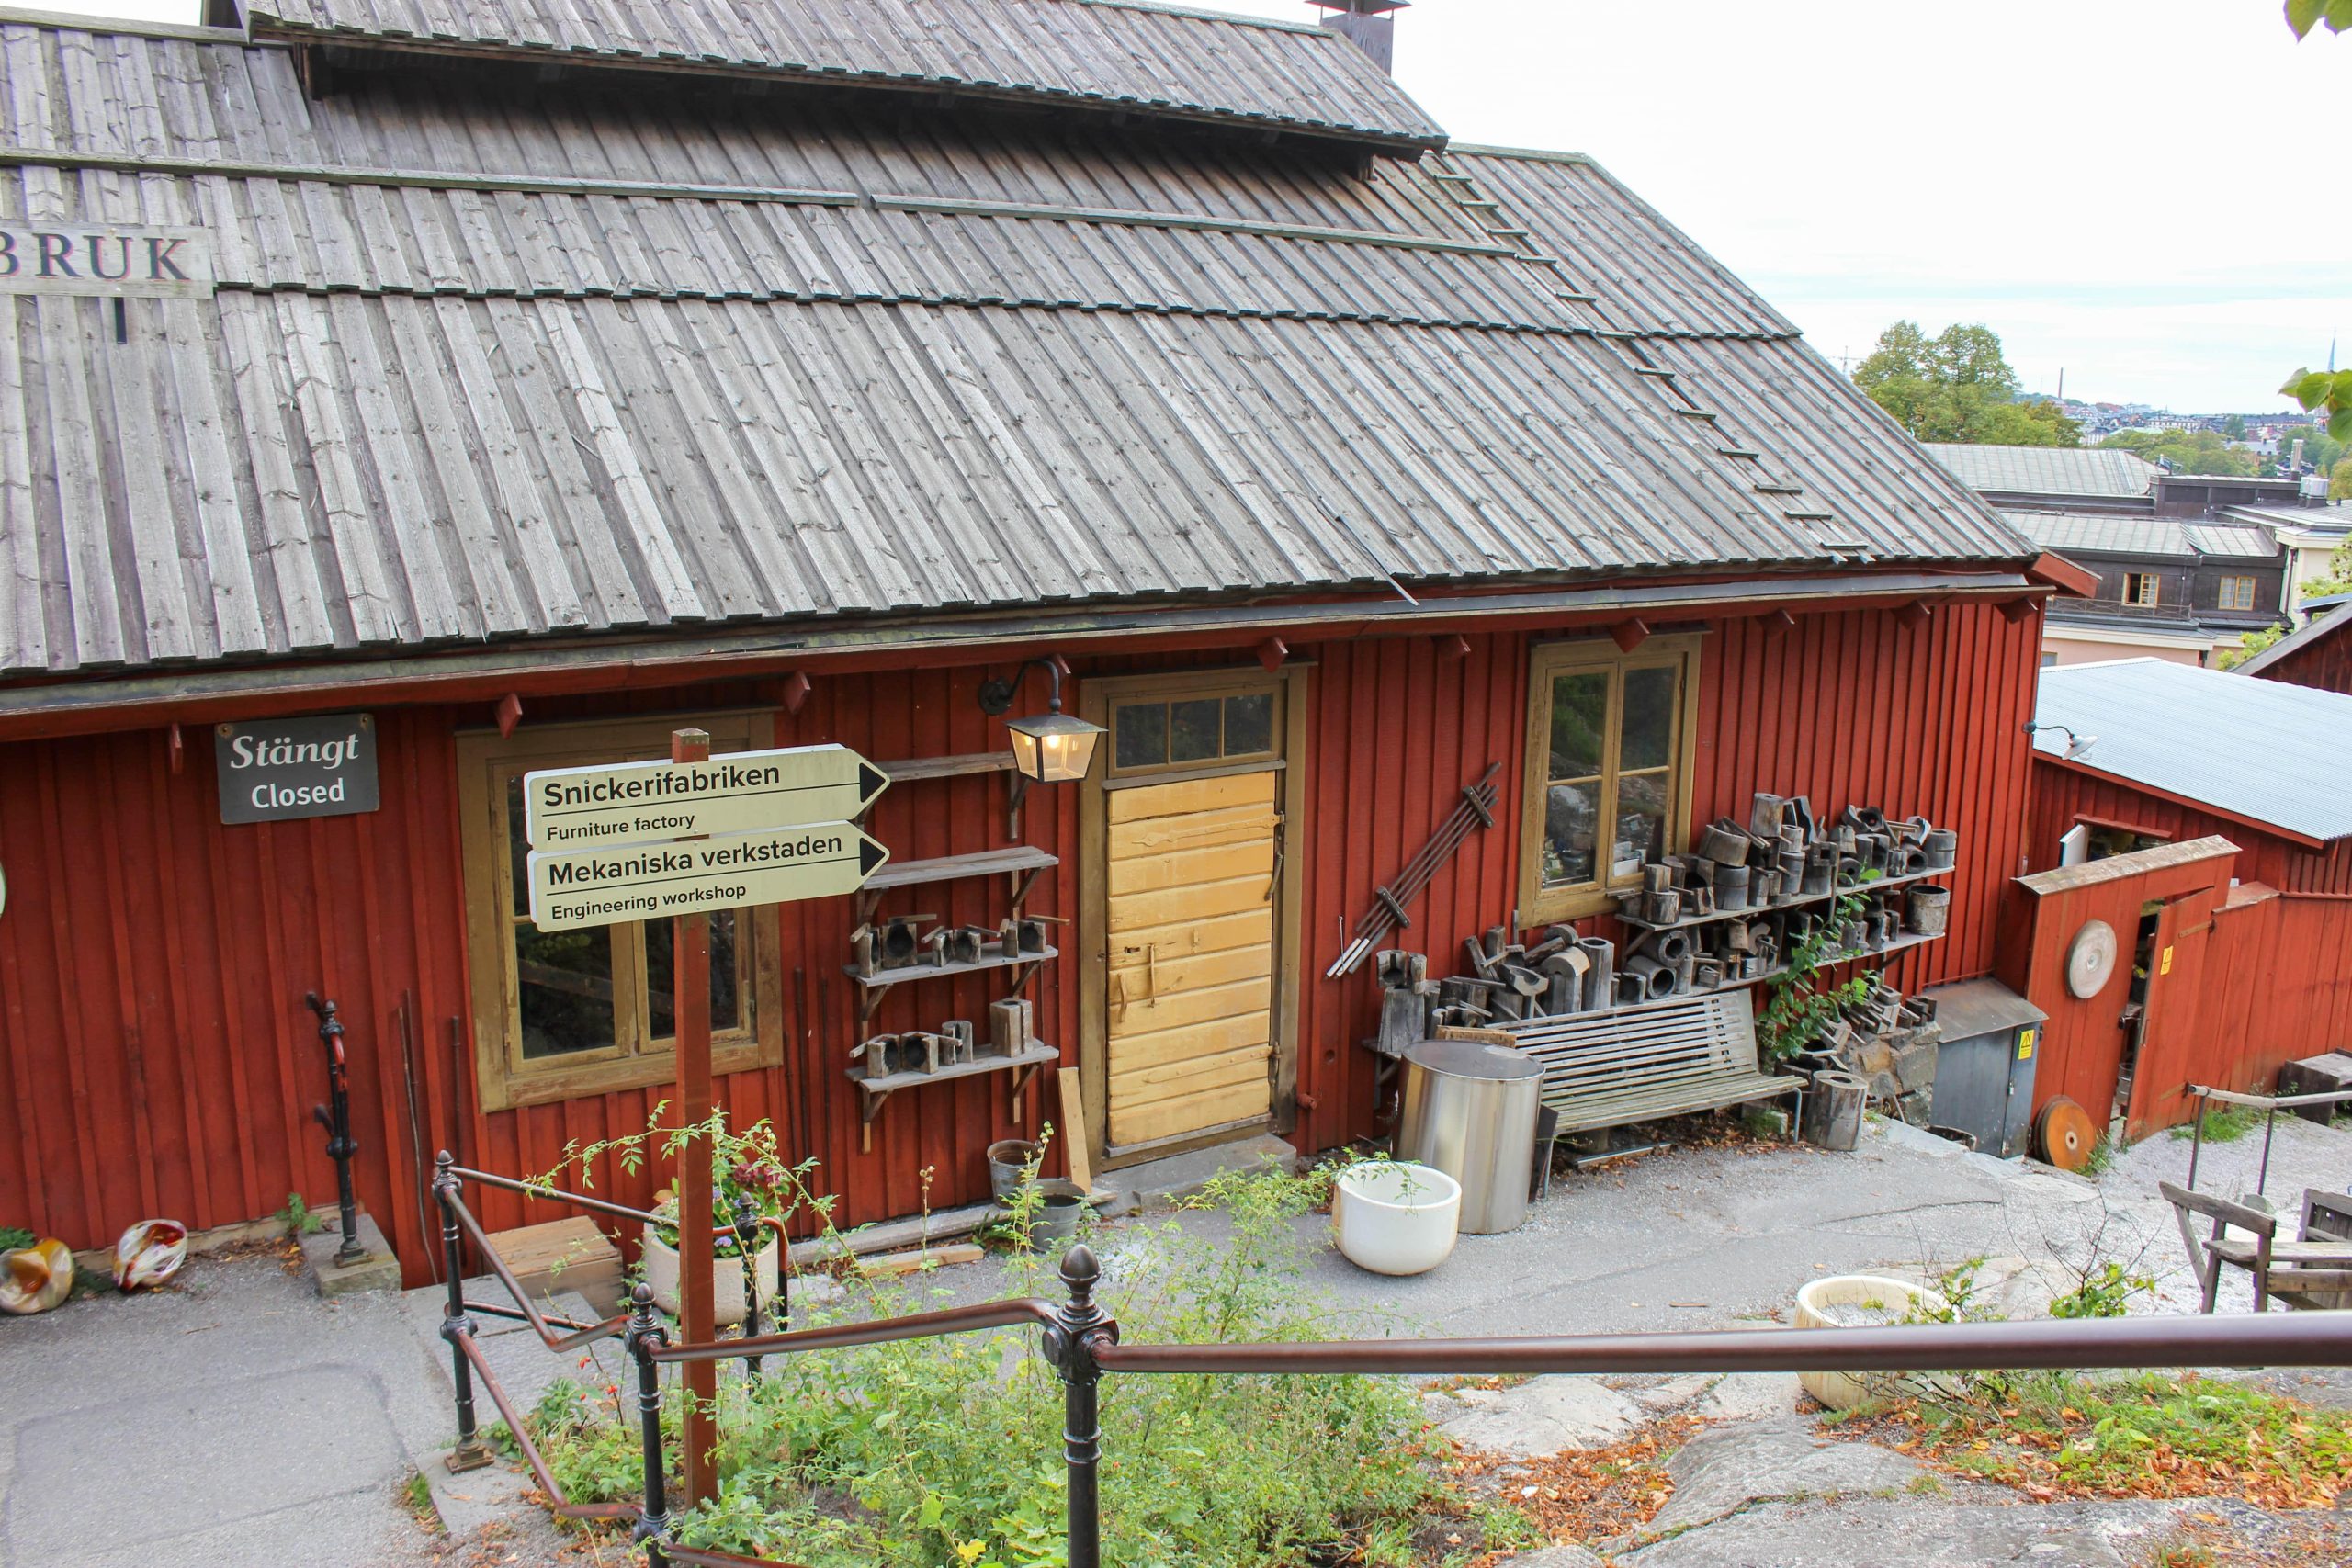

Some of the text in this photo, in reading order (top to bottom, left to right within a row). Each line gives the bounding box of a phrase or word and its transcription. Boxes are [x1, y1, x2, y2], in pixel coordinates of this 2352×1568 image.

[230, 733, 359, 770] Stängt
[251, 777, 345, 809] Closed
[544, 765, 780, 807] Snickerifabriken
[547, 813, 695, 841] Furniture factory
[549, 834, 842, 886] Mekaniska verkstaden
[551, 884, 746, 920] Engineering workshop
